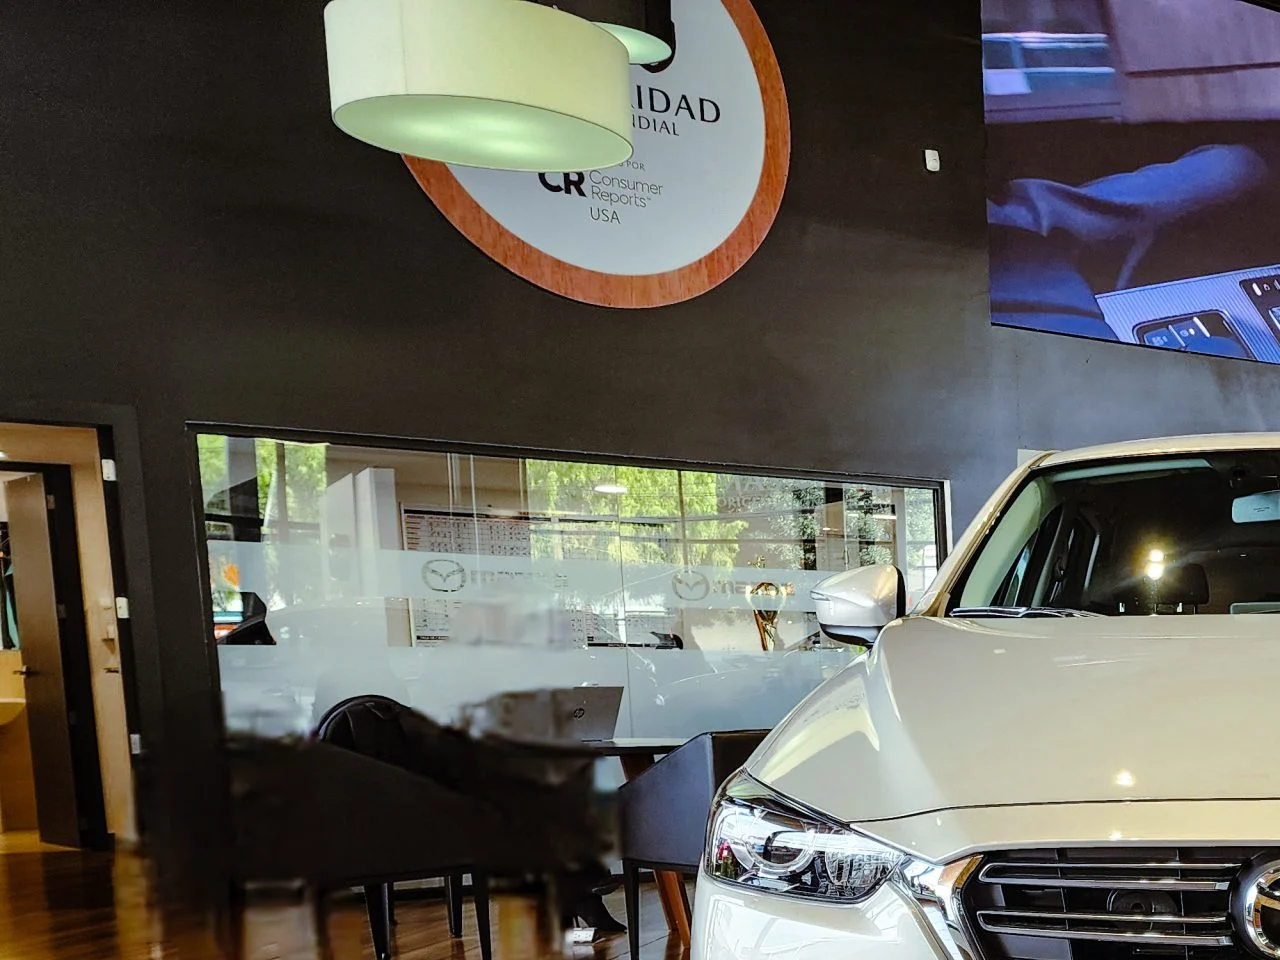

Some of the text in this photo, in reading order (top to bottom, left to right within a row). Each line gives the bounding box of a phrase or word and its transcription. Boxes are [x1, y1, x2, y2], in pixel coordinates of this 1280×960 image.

[631, 84, 721, 123] IDAD
[538, 172, 587, 197] CR
[589, 170, 664, 195] Consumer
[590, 206, 621, 224] USA
